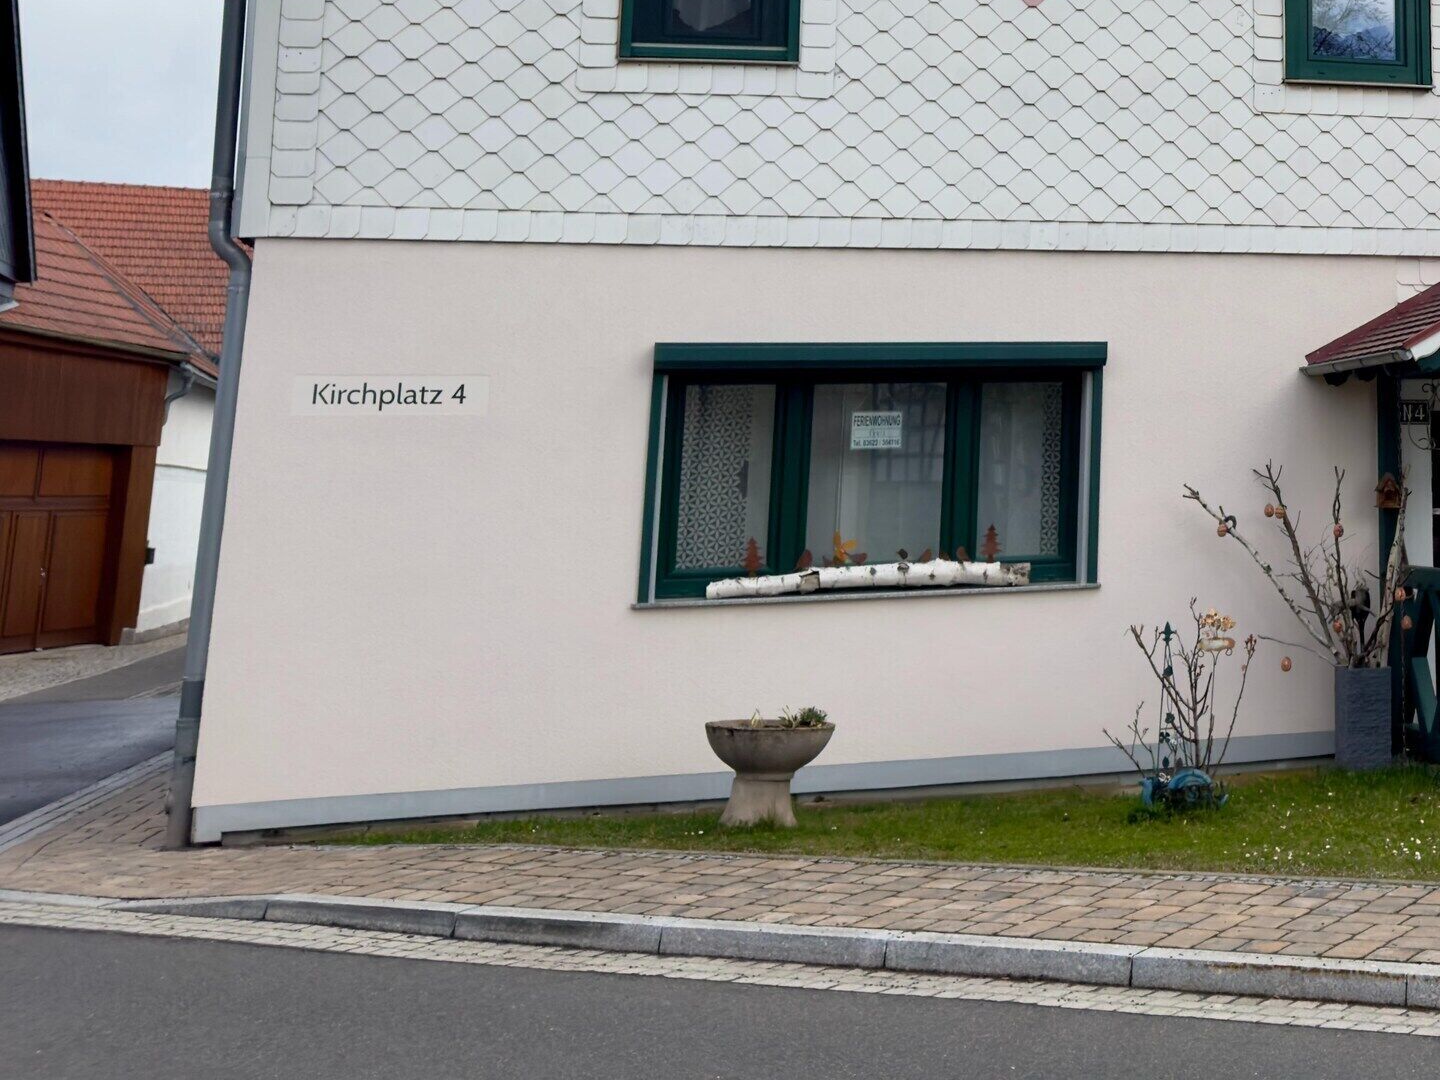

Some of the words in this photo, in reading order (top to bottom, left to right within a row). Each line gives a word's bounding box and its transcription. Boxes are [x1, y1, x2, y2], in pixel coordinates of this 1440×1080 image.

[312, 382, 443, 411] Kirchplatz
[451, 384, 467, 405] 4
[853, 414, 901, 427] FERIENWOHNUNG
